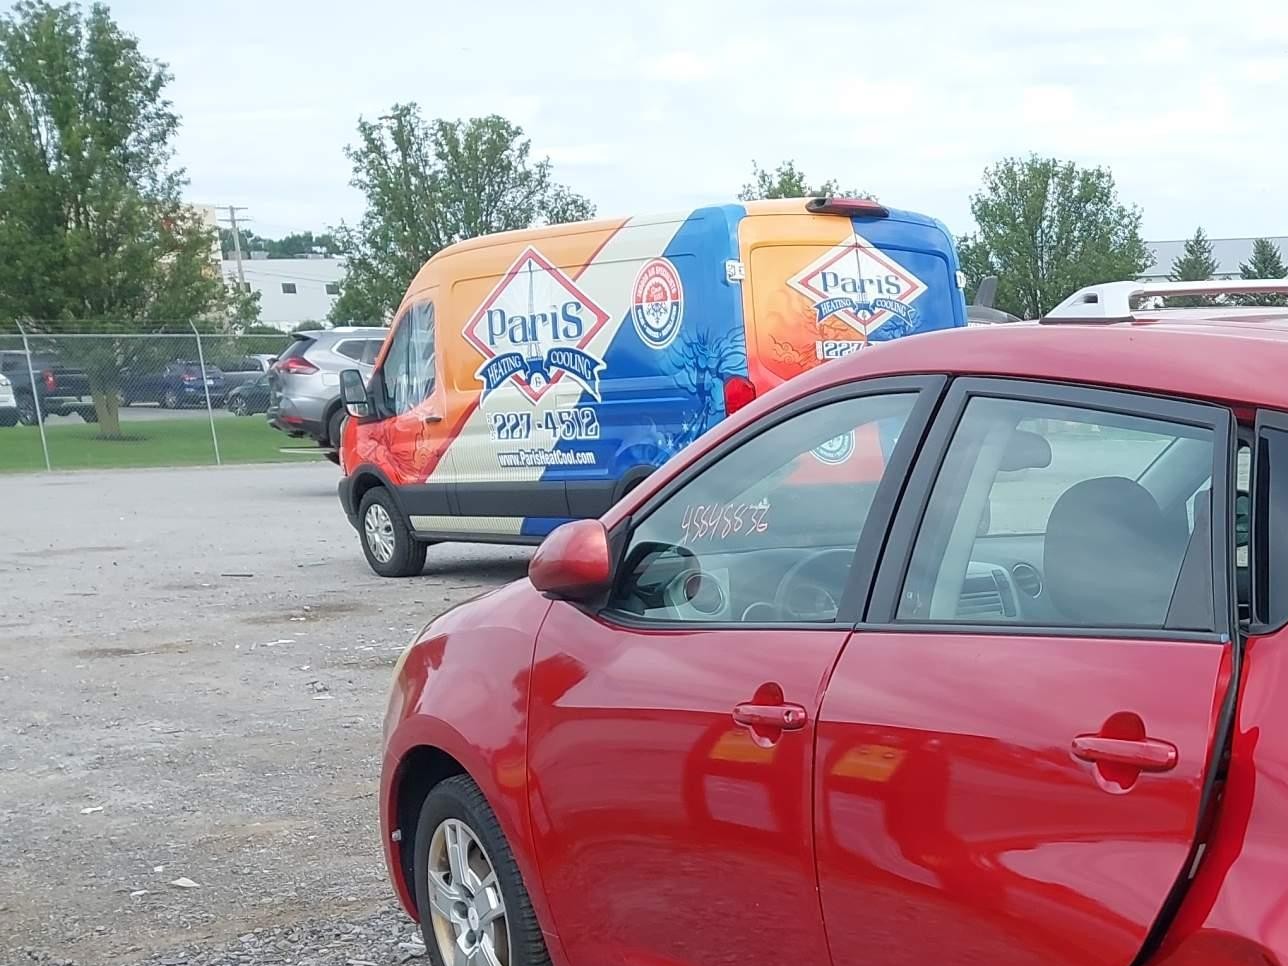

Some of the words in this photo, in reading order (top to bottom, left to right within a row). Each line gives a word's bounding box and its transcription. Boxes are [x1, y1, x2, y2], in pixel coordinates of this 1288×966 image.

[821, 299, 851, 315] HEATING
[876, 299, 906, 316] COOLING
[487, 355, 522, 388] HEATING
[550, 350, 592, 380] COOLING
[498, 449, 596, 466] www.ParisHeatCool.com
[682, 502, 771, 545] 45848836
